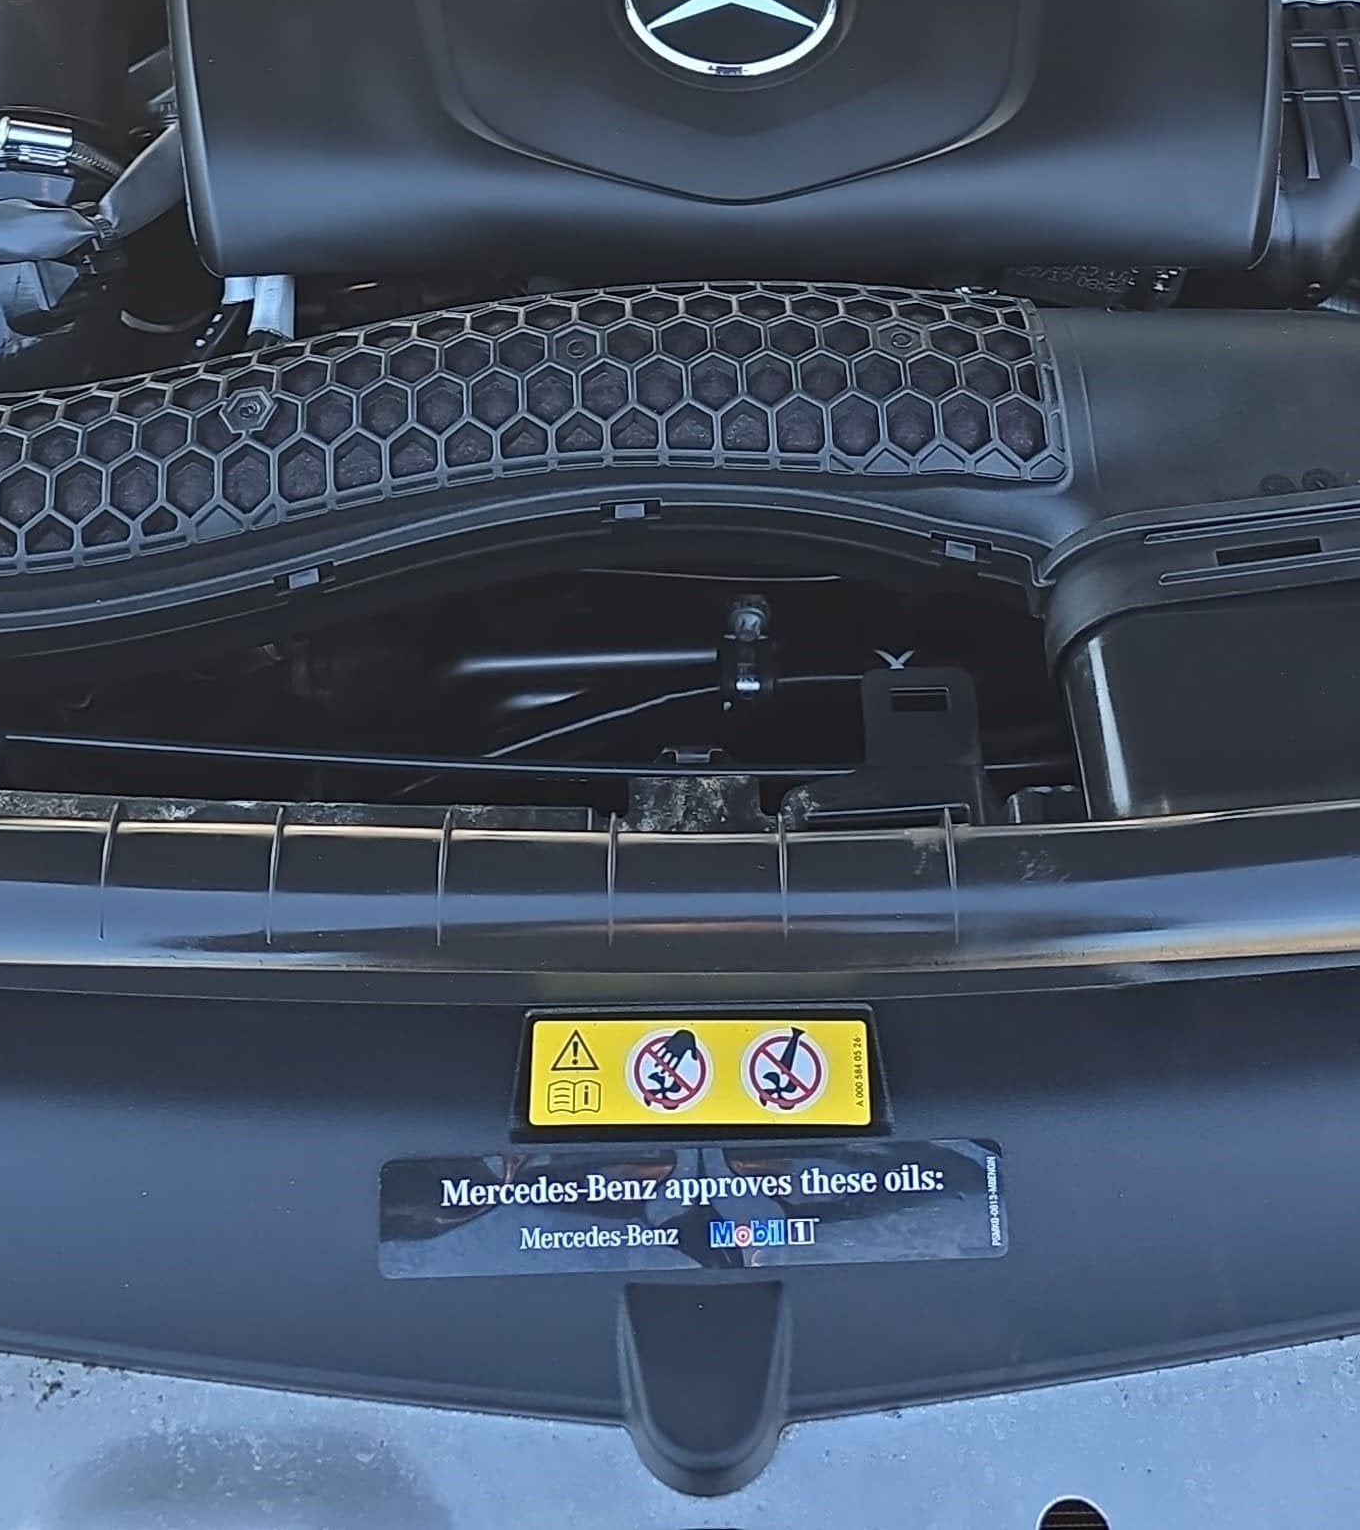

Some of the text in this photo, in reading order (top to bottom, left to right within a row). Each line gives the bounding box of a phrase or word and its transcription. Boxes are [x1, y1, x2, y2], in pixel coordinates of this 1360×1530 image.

[851, 1036, 865, 1108] A 000 584 05 26
[440, 1164, 945, 1207] Mercedes-Benz approves these oils:
[519, 1224, 680, 1250] Mercedes-Benz
[710, 1219, 785, 1248] Mobil
